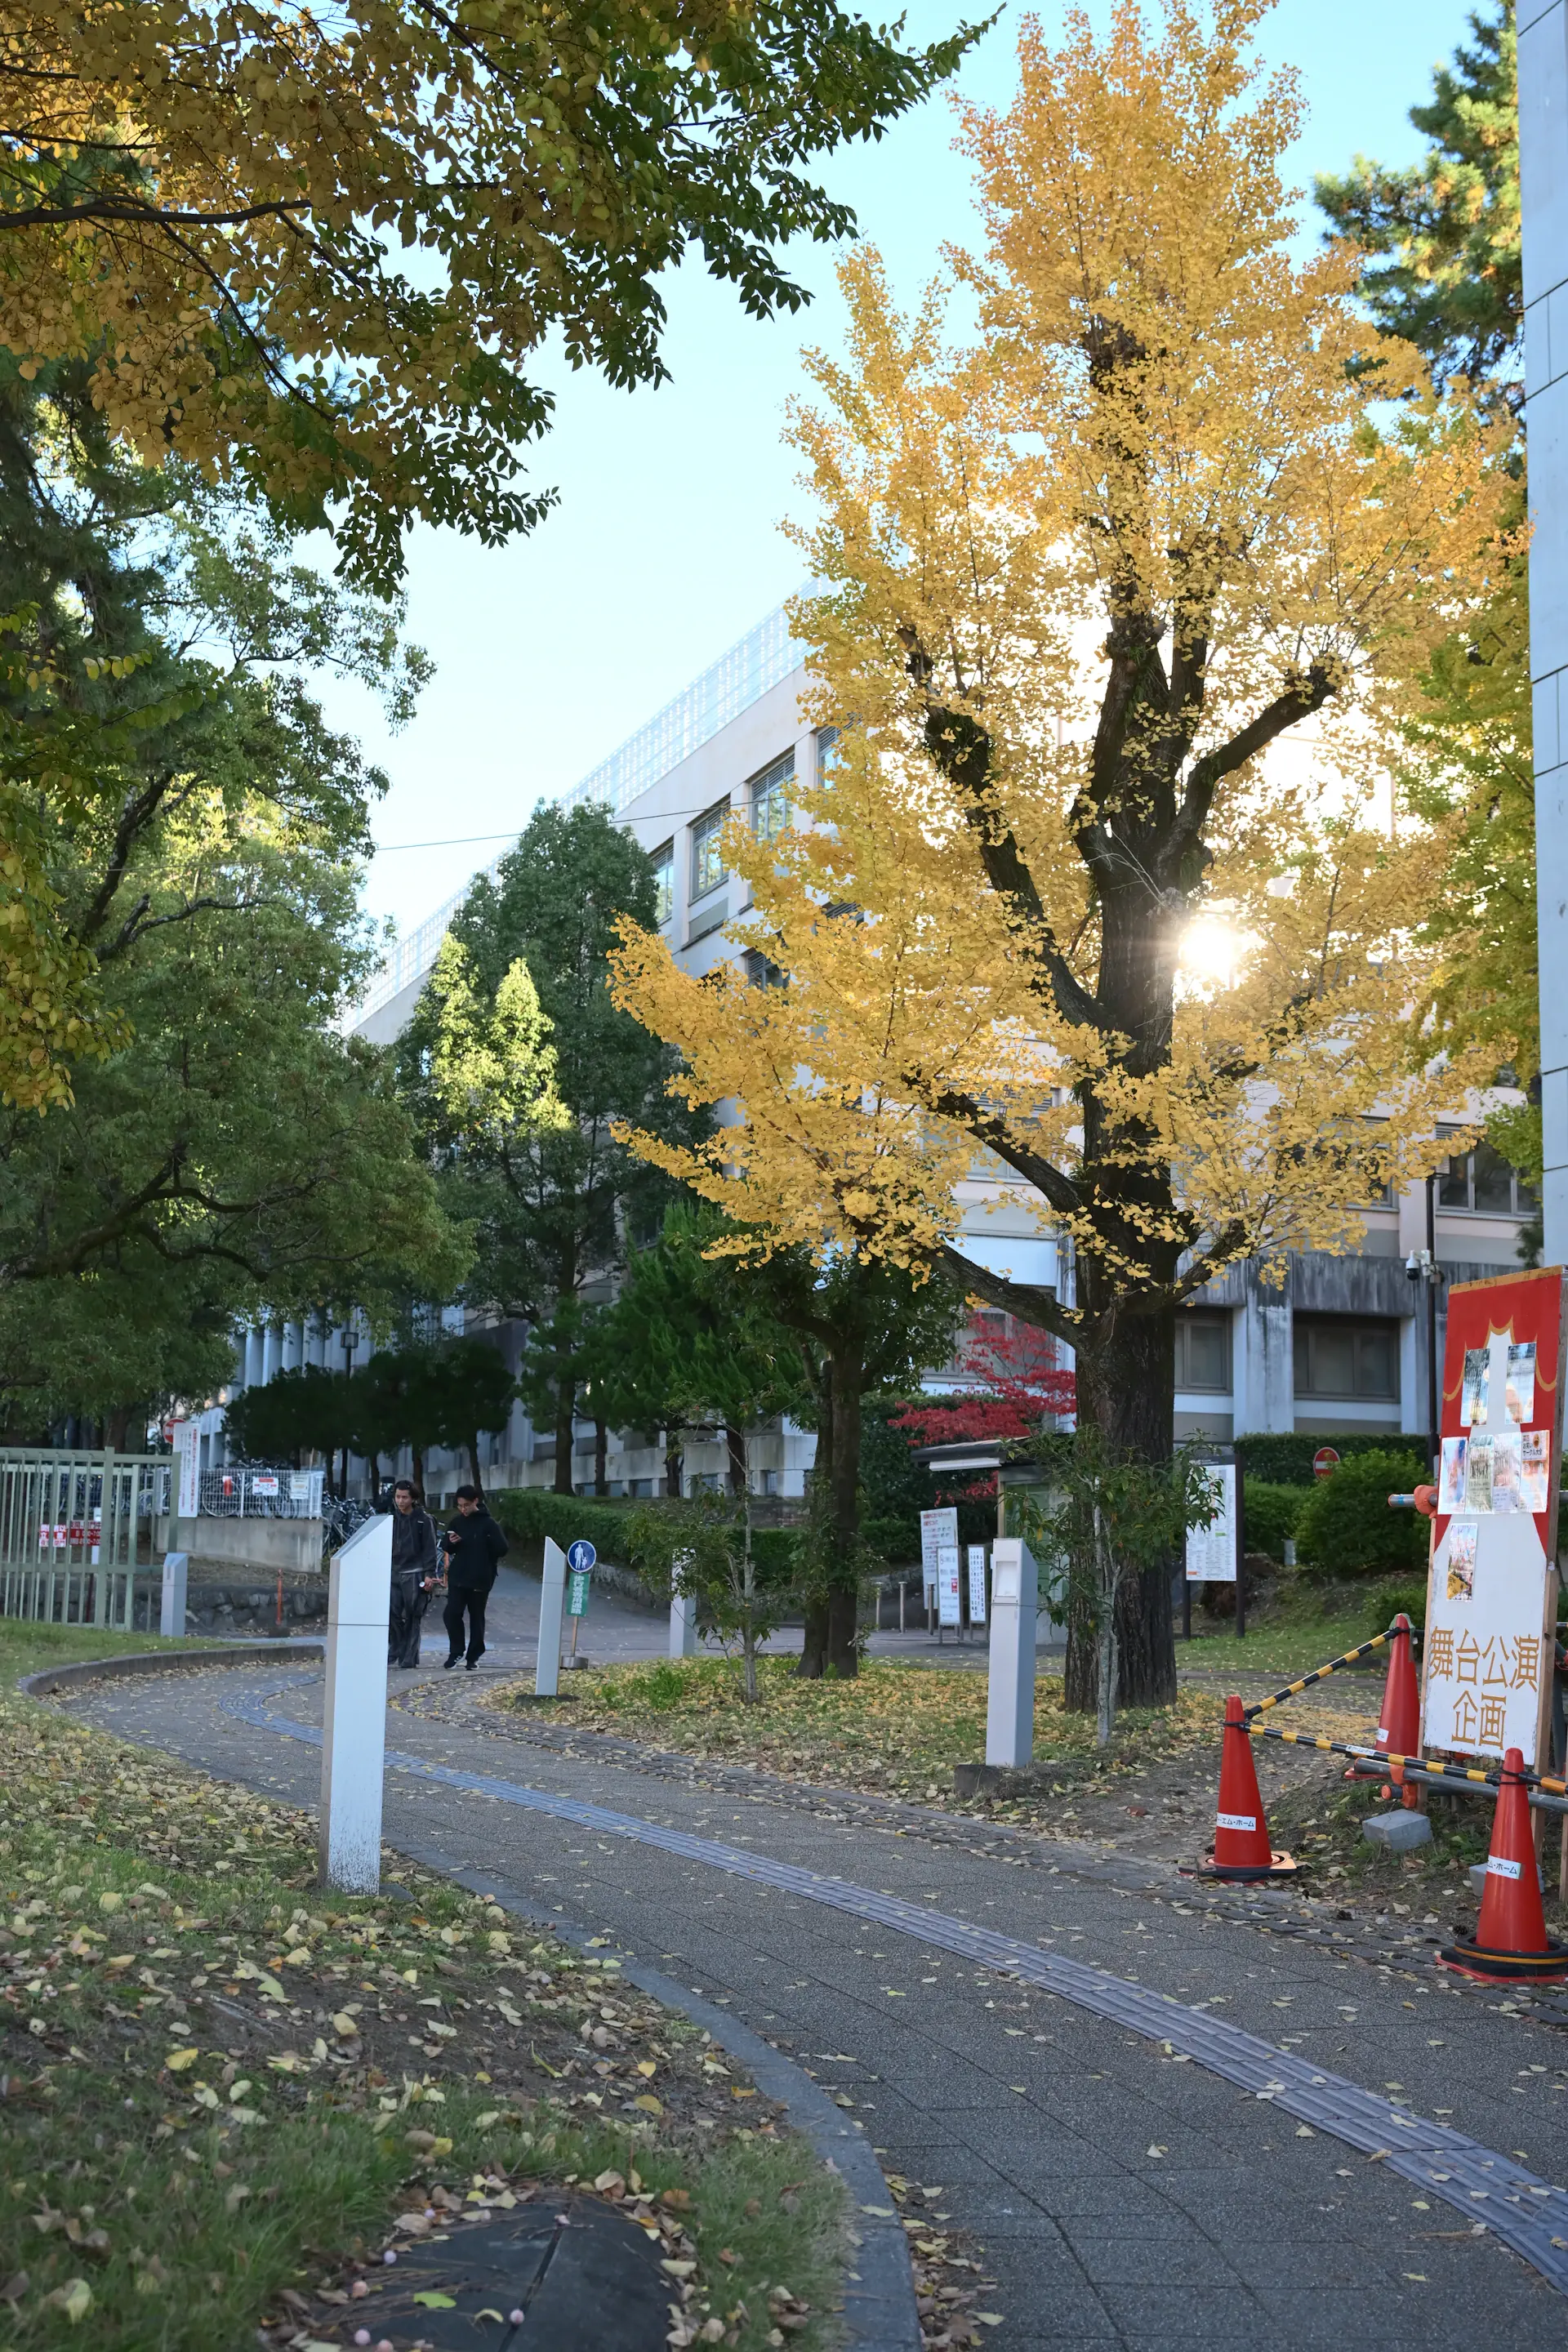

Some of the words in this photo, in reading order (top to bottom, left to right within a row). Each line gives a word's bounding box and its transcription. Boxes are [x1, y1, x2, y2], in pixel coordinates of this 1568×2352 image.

[1430, 1625, 1539, 1692] 舞台公演
[1451, 1690, 1507, 1750] 企画
